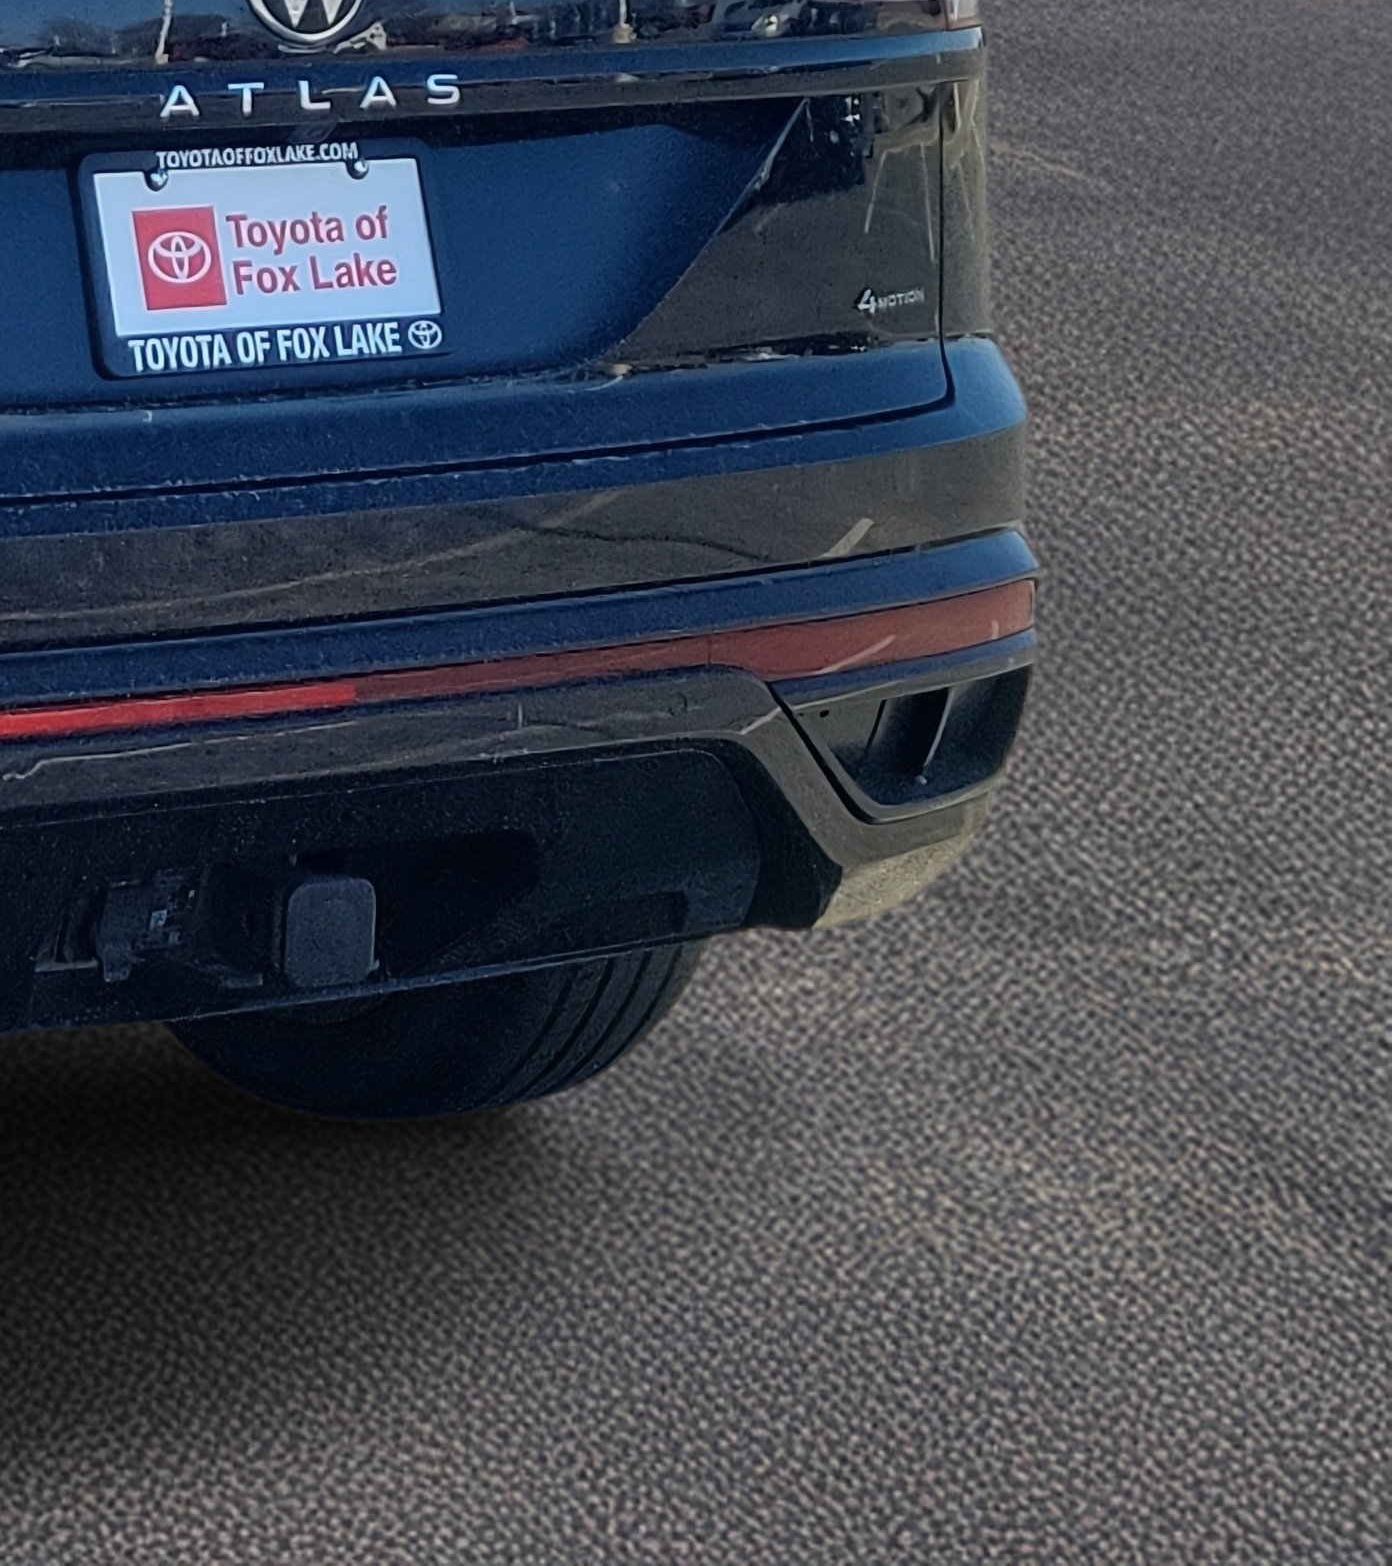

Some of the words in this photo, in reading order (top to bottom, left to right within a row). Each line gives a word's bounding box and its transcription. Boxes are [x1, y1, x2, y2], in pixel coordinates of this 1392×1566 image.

[160, 74, 461, 118] ATLAS
[156, 142, 358, 169] TOYOTAOFFOXLAKE.COM
[226, 211, 344, 255] Toyota
[356, 205, 388, 240] of
[232, 260, 300, 295] Fox
[309, 254, 397, 290] Lake
[128, 334, 231, 372] TOYOTA
[237, 330, 271, 364] OF
[277, 326, 331, 361] FOX
[334, 322, 402, 357] LAKE
